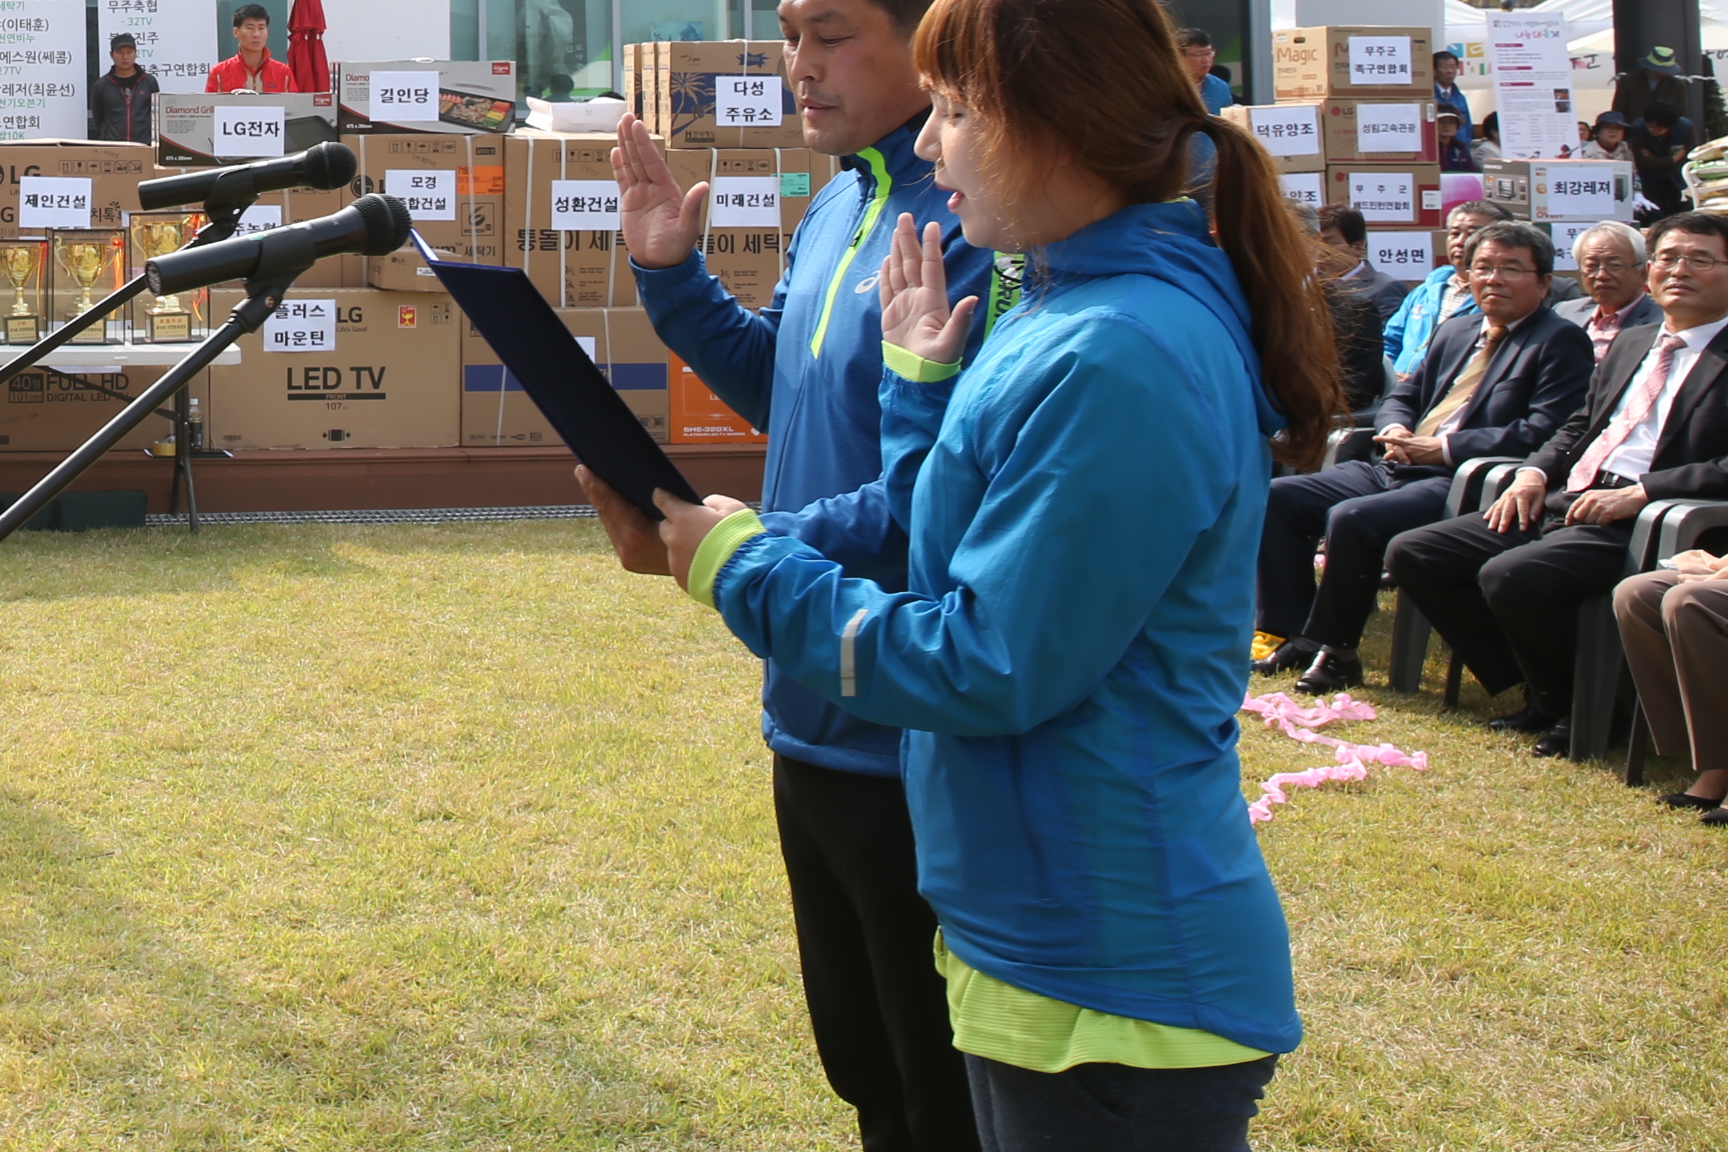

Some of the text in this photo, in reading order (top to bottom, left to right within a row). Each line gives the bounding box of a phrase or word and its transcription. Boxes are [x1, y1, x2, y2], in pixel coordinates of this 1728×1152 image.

[107, 0, 158, 13] 무주축협
[128, 17, 152, 26] 32TV
[1277, 48, 1317, 65] Magic
[1365, 46, 1396, 56] 무주군
[1355, 64, 1408, 74] 족구연합회
[734, 81, 764, 96] 다성
[380, 88, 429, 104] 길인당
[166, 106, 199, 114] Diamond
[726, 108, 774, 122] 주유소
[222, 122, 280, 137] LG전자
[1257, 123, 1314, 137] 덕유양조
[1362, 124, 1416, 134] 성림고속관광
[411, 176, 436, 189] 모경
[1554, 181, 1610, 195] 최강레져
[24, 194, 86, 209] 제인건설
[555, 197, 618, 212] 성환건설
[717, 194, 775, 207] 미래건설
[1354, 201, 1410, 210] 배드민턴연합회
[1379, 249, 1424, 264] 안성면
[276, 304, 326, 319] 플러스
[337, 307, 363, 323] LG
[275, 331, 324, 346] 마운틴
[102, 374, 129, 390] HD
[287, 366, 386, 390] LED TV
[12, 393, 42, 401] 101cm
[47, 393, 110, 402] DIGITAL LED
